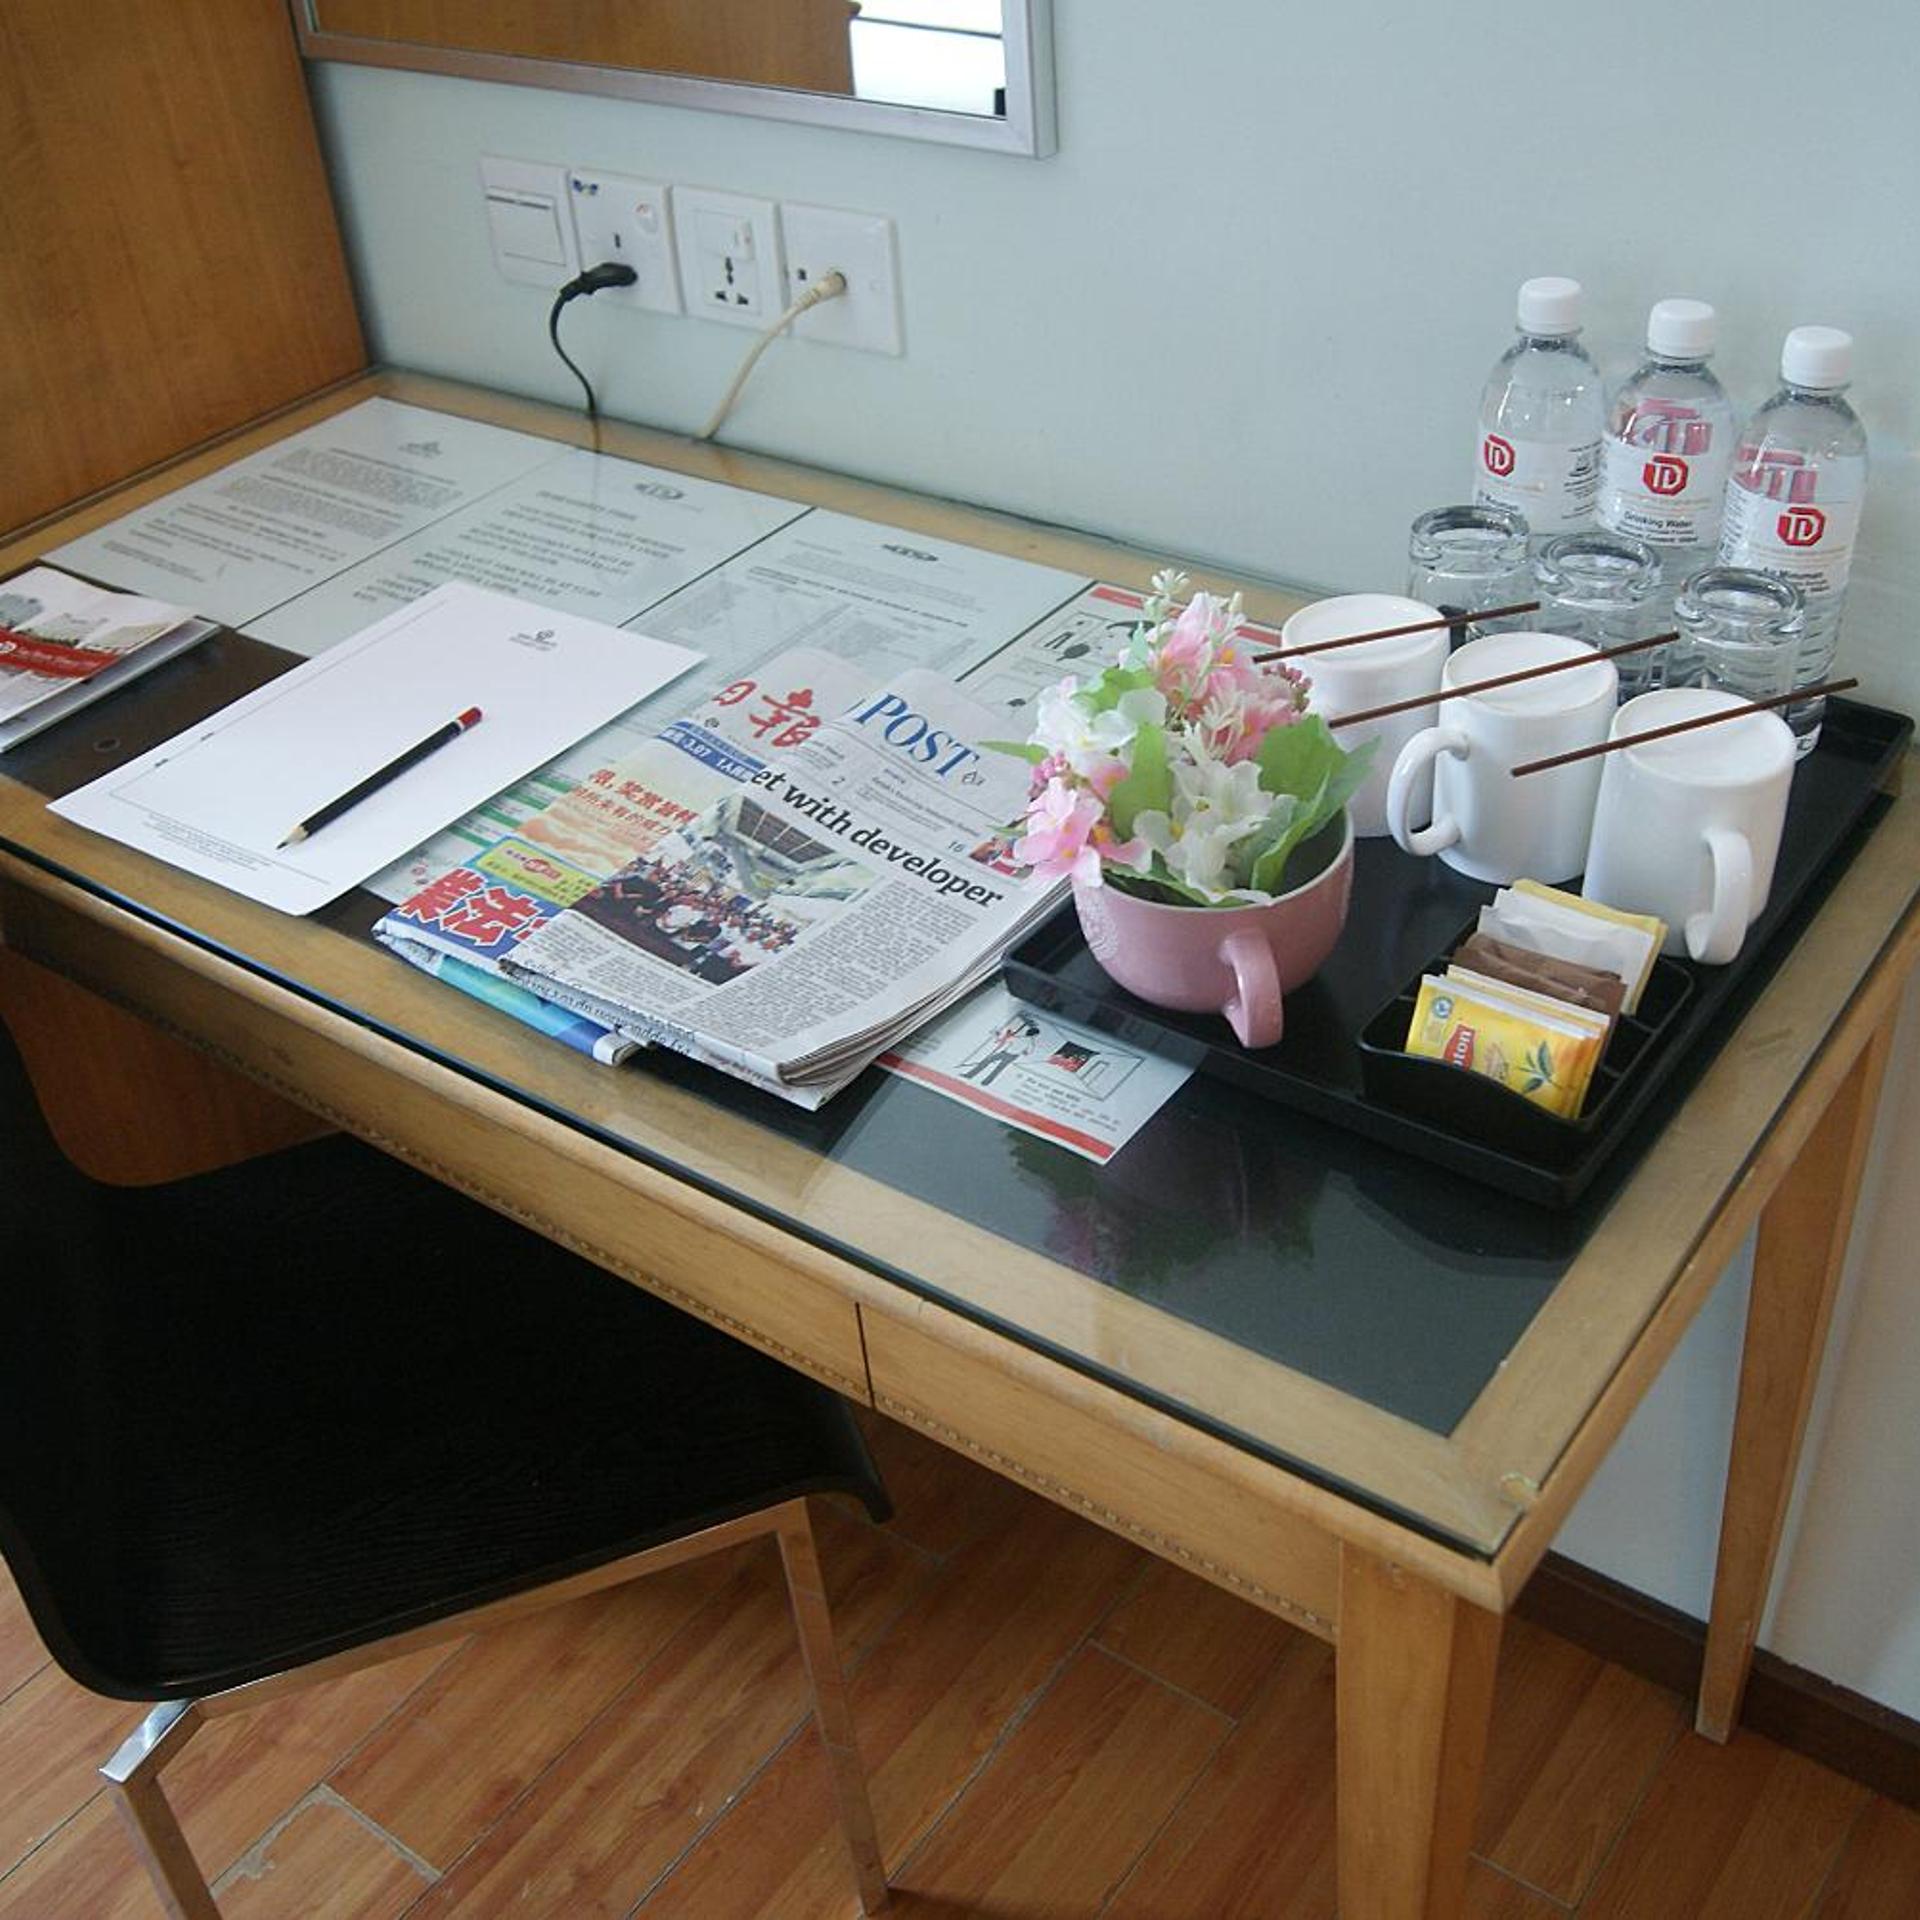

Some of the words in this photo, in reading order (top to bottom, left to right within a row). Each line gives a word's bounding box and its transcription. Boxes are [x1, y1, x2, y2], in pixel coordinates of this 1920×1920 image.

[853, 693, 980, 777] POST
[782, 785, 853, 836] with
[850, 827, 1004, 908] developer
